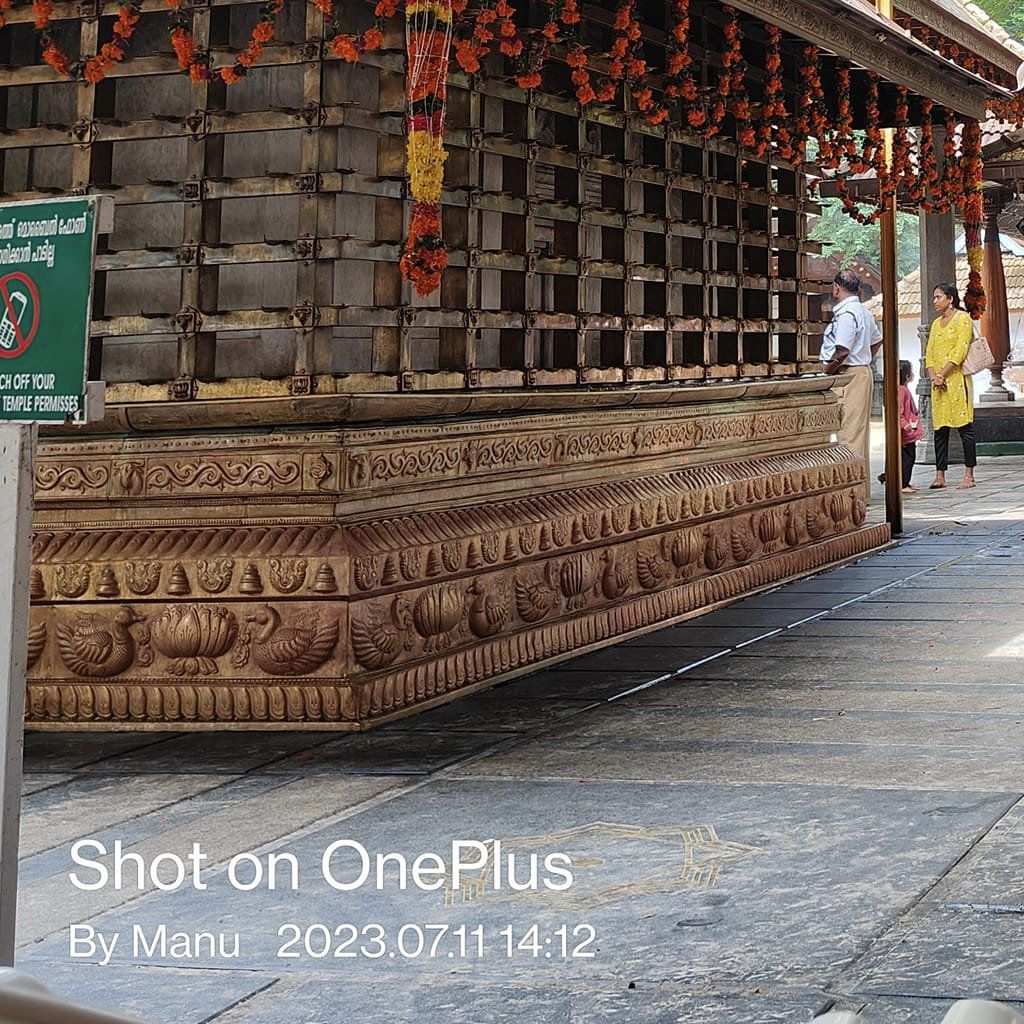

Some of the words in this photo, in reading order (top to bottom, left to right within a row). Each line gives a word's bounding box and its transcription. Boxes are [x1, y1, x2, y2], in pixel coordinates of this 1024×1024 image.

[13, 373, 31, 390] OFF
[31, 373, 56, 390] YOUR
[2, 395, 33, 412] TEMPLE
[34, 395, 79, 413] PERMISSES
